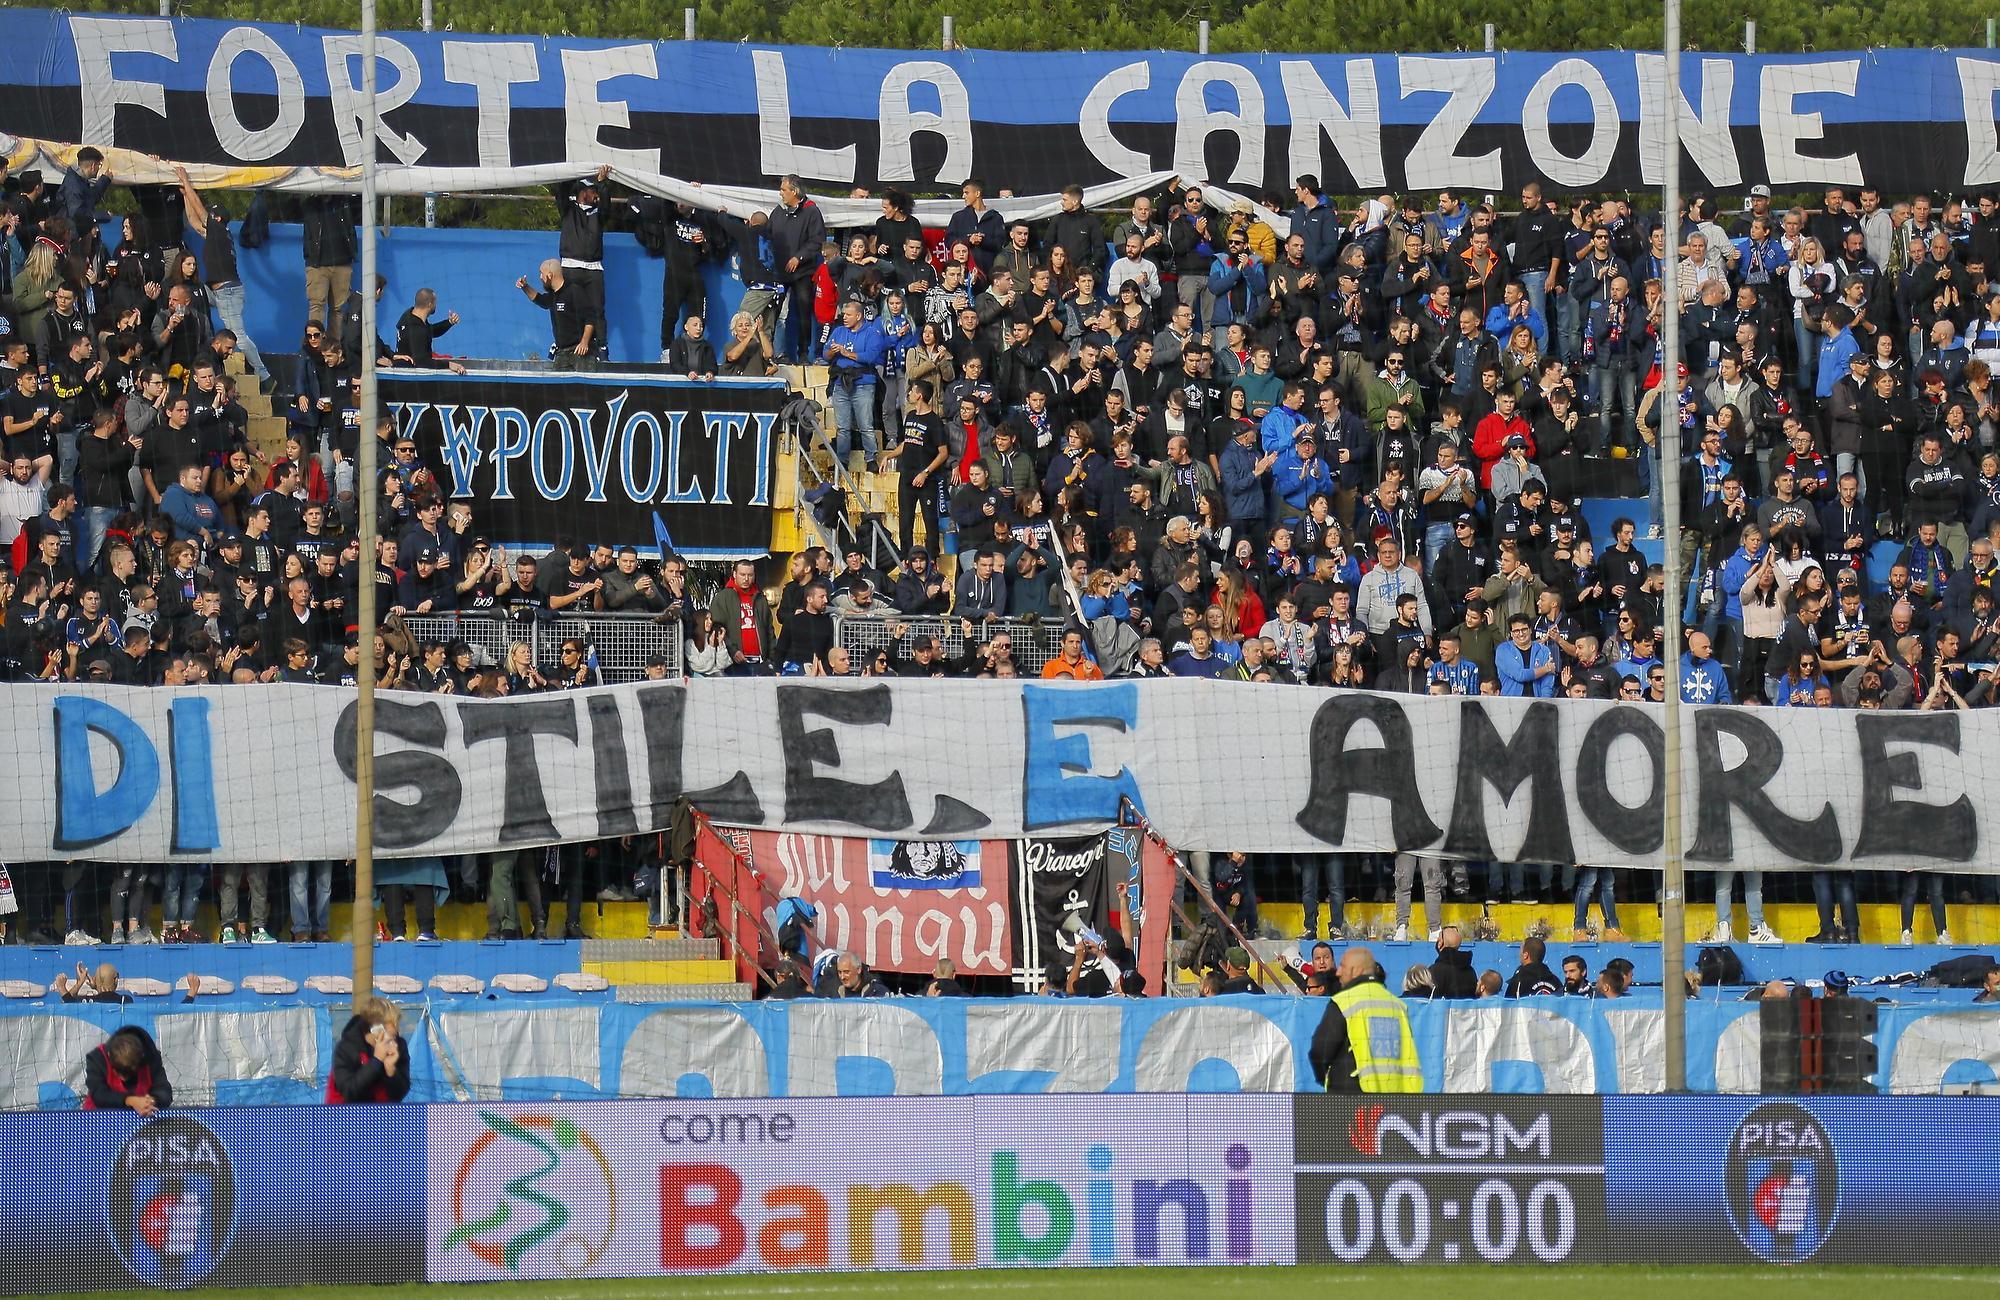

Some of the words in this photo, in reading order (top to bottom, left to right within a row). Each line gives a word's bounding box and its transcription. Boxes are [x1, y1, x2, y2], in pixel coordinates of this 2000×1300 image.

[69, 16, 661, 174] FORTE
[752, 50, 974, 184] LA
[1079, 53, 1865, 190] CANZONE
[1389, 450, 1404, 459] PISA
[473, 596, 494, 607] 1909
[53, 696, 220, 855] DI
[1022, 682, 1146, 833] E
[1296, 694, 1978, 865] AMORE
[659, 1108, 796, 1146] come
[1375, 1111, 1553, 1160] NGM
[1738, 1121, 1824, 1152] PISA
[127, 1134, 221, 1167] PISA
[658, 1142, 1254, 1271] Bambini
[1323, 1178, 1577, 1264] 00:00
